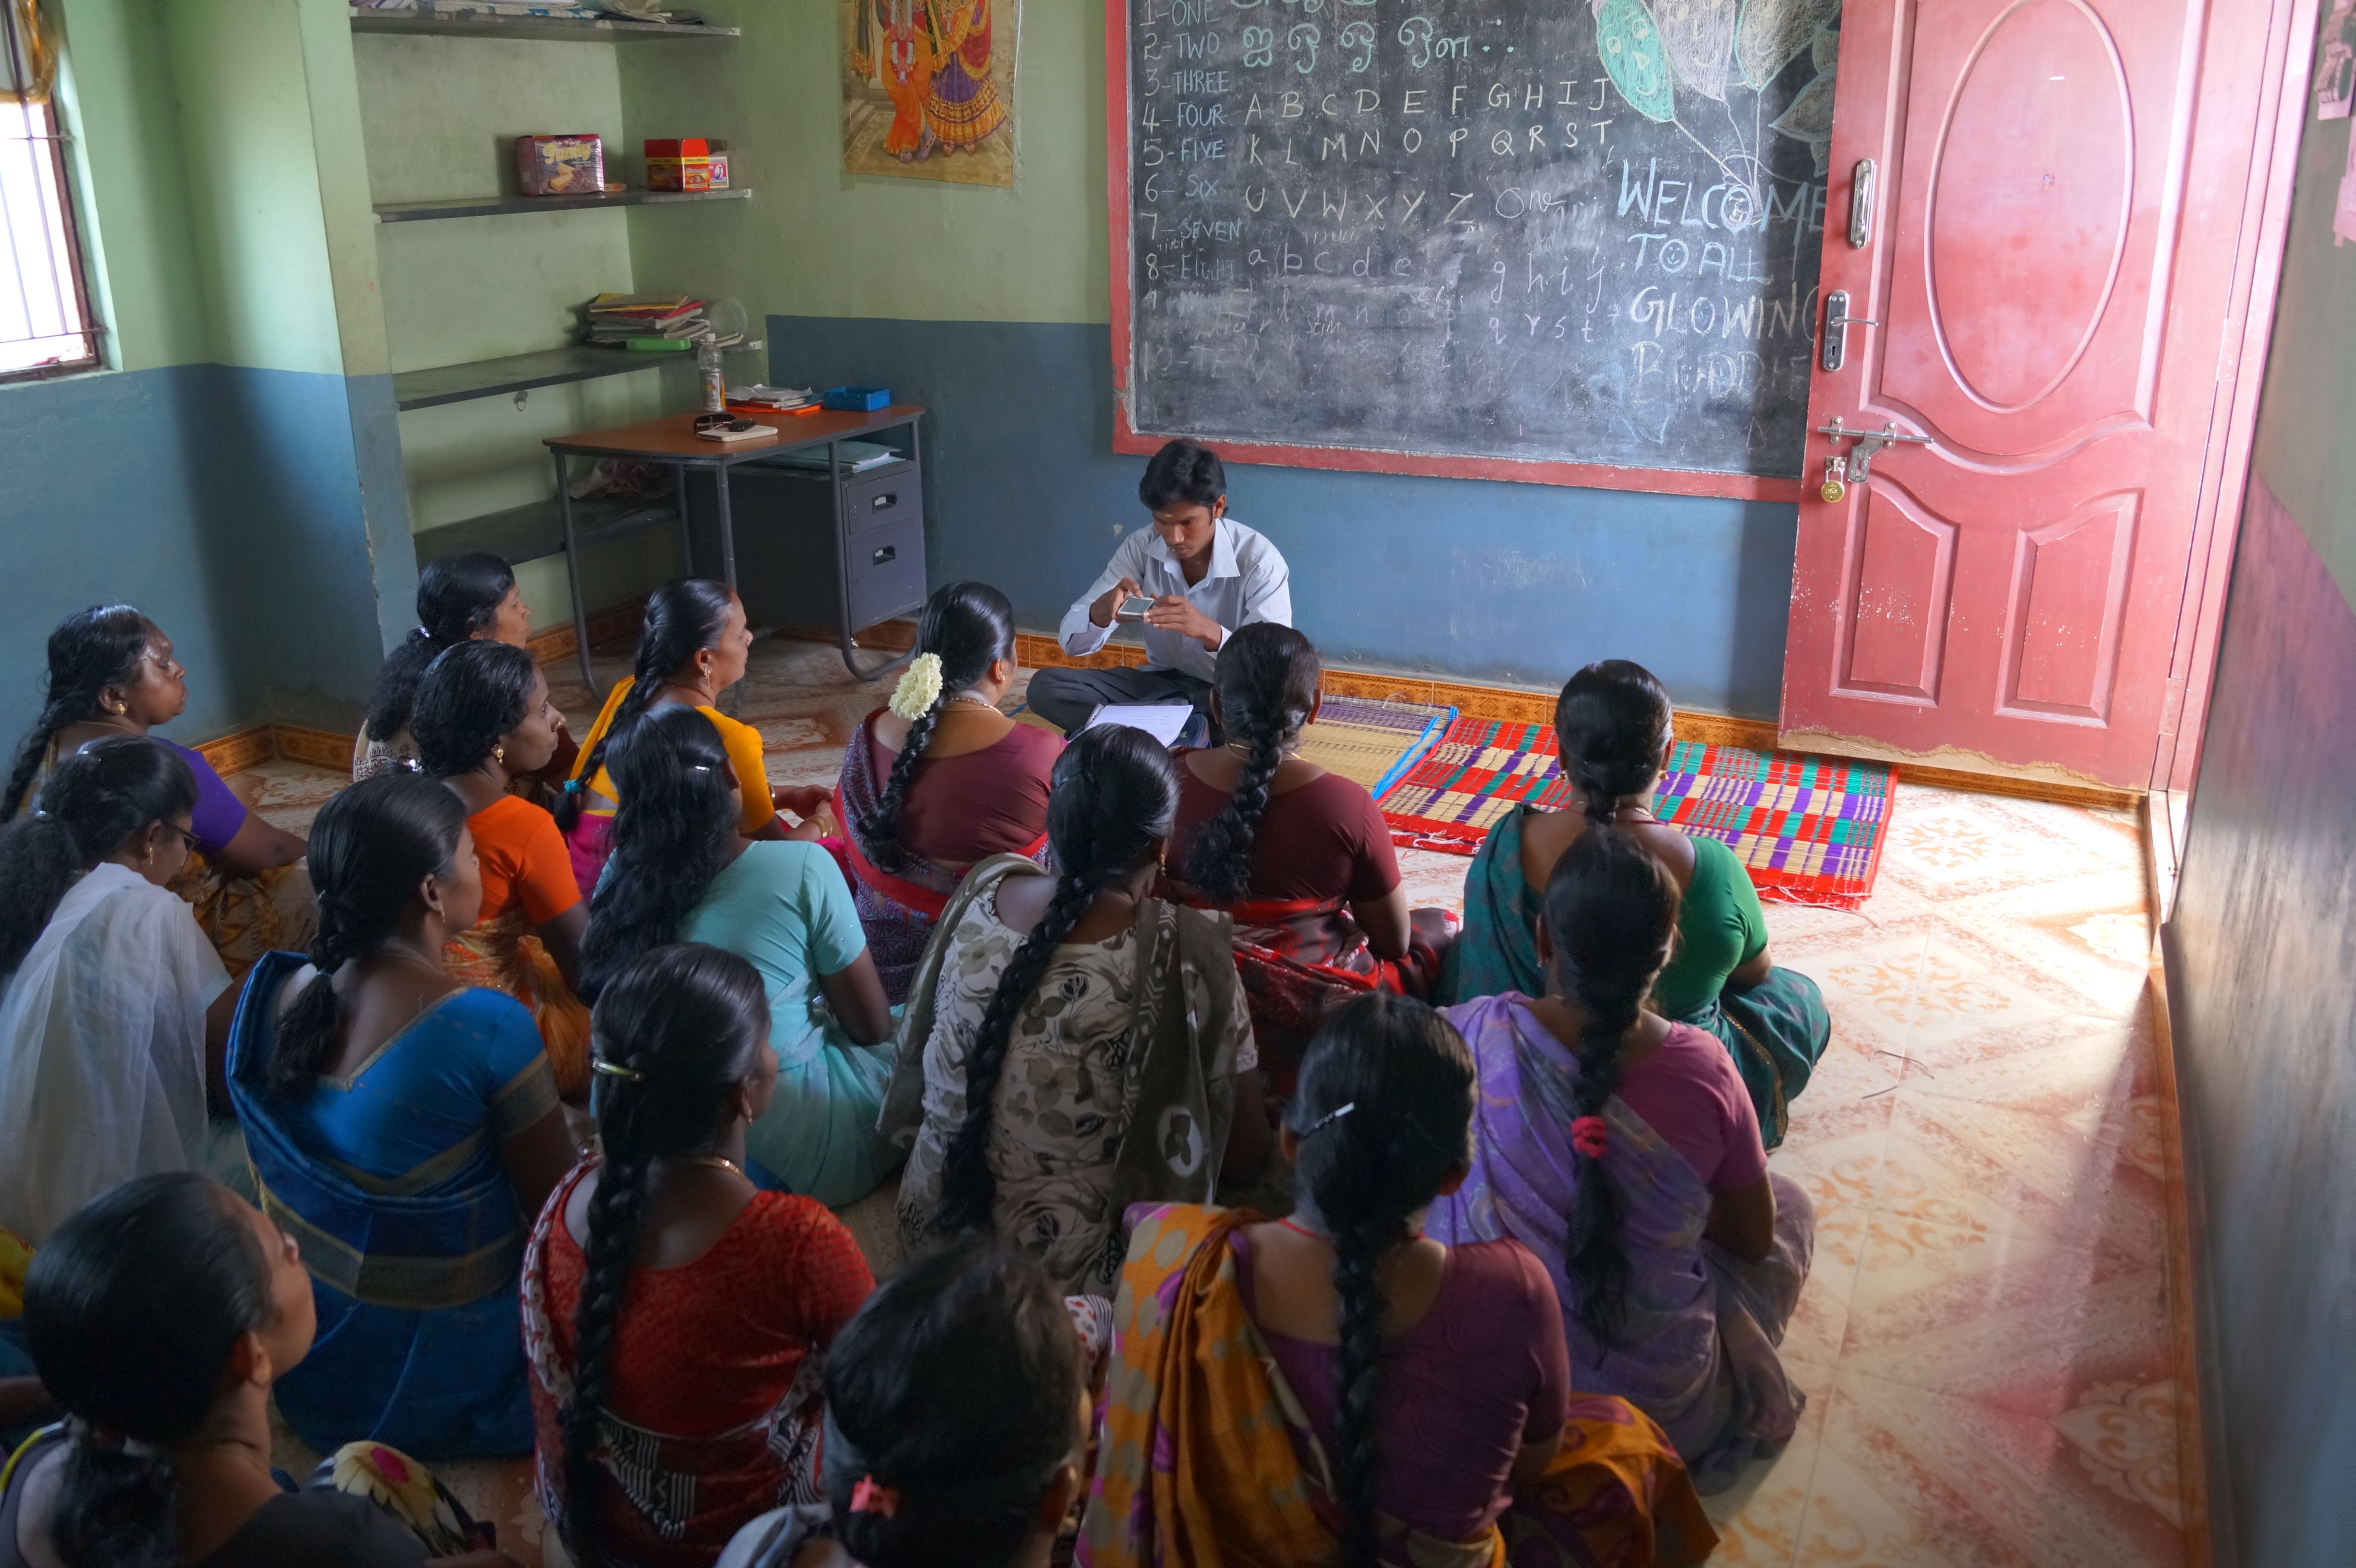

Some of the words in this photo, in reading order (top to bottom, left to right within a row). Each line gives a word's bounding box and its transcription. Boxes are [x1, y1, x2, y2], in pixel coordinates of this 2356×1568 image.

[1243, 26, 1273, 67] ஐ
[1288, 23, 1320, 73] ஒ
[1341, 21, 1375, 73] ஓ
[1245, 93, 1261, 125] A
[1281, 92, 1304, 117] B
[1322, 94, 1337, 115] C
[1355, 89, 1380, 114] D
[1404, 90, 1426, 113] E
[1452, 86, 1467, 115] F
[1488, 83, 1510, 108] G
[1524, 83, 1543, 111] H
[1558, 81, 1578, 105] I
[1588, 78, 1610, 111] J
[1250, 134, 1263, 165] K
[1286, 138, 1297, 164] L
[1322, 133, 1347, 162] M
[1360, 130, 1379, 155] N
[1403, 128, 1422, 153] O
[1449, 128, 1468, 158] P
[1491, 130, 1514, 156] Q
[1529, 125, 1545, 152] R
[1565, 122, 1578, 148] S
[1591, 119, 1613, 145] T
[1246, 185, 1265, 212] U
[1281, 188, 1306, 218] V
[1323, 189, 1347, 221] W
[1365, 193, 1388, 222] X
[1403, 190, 1425, 224] Y
[1444, 192, 1475, 224] Z
